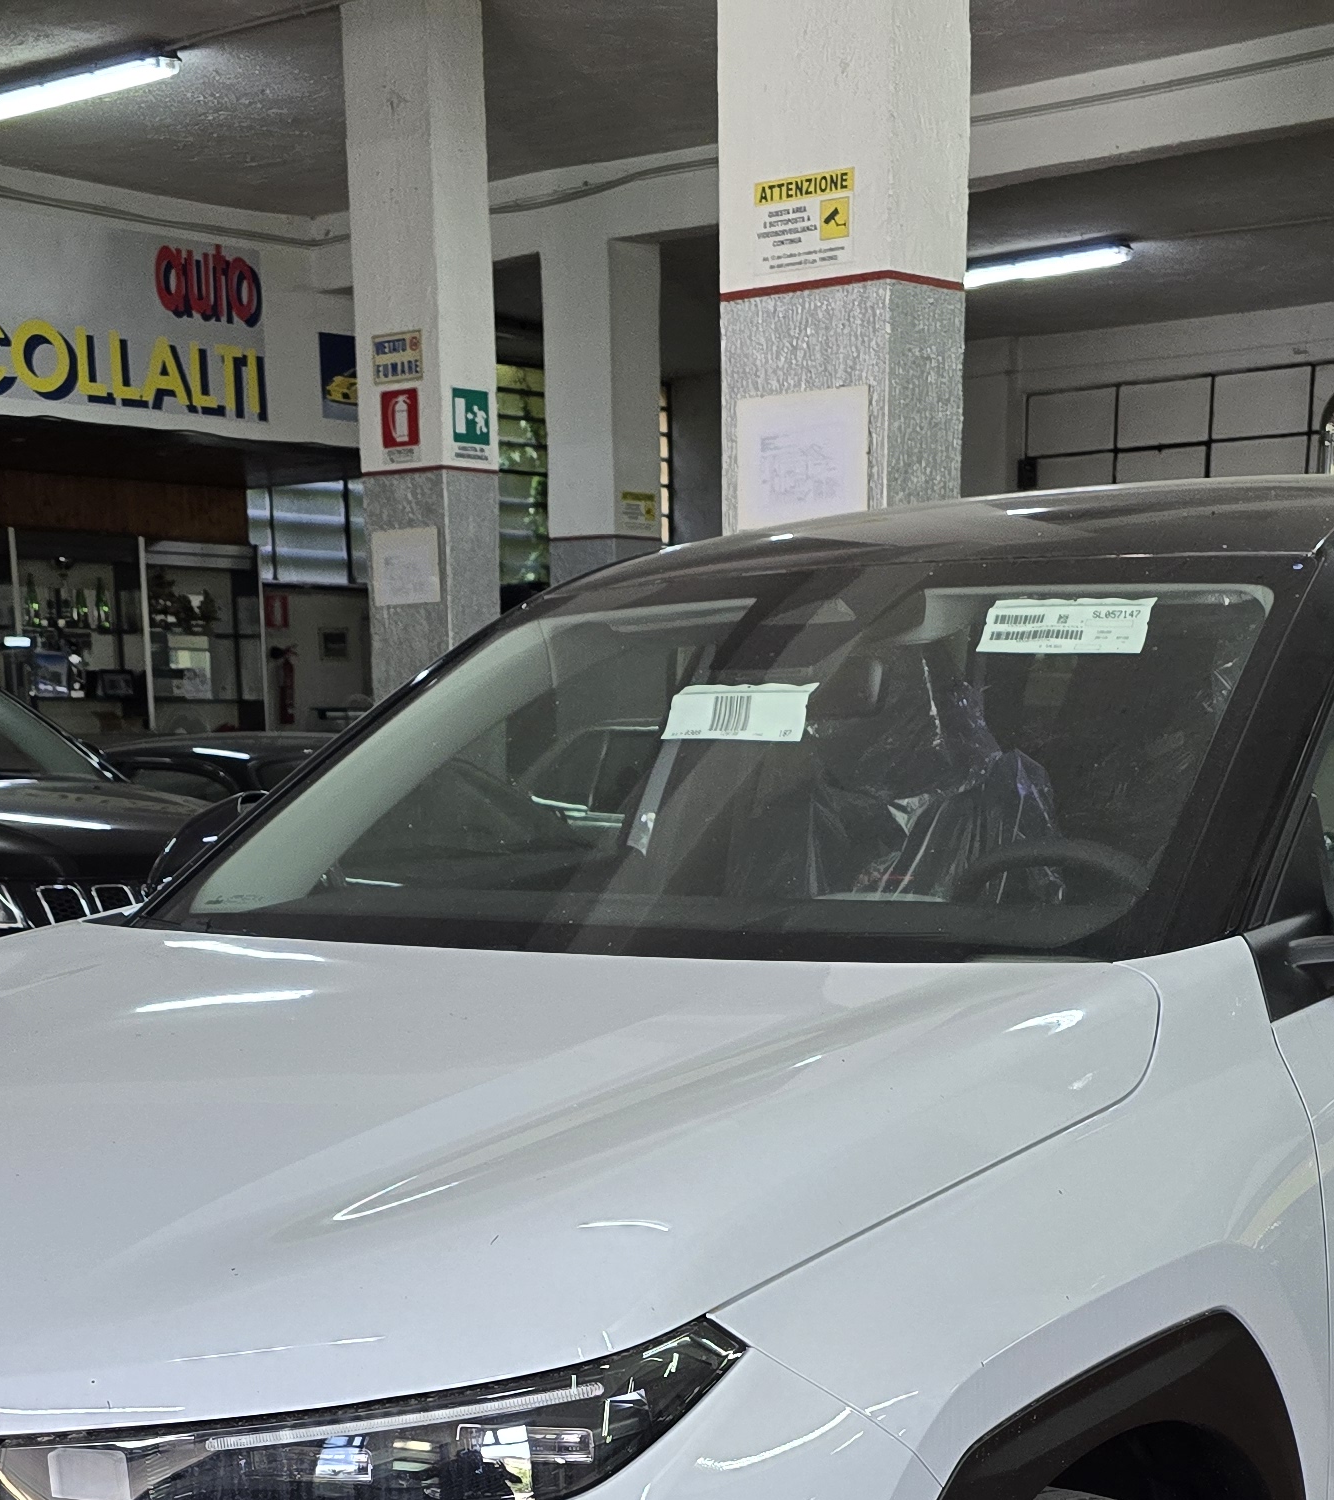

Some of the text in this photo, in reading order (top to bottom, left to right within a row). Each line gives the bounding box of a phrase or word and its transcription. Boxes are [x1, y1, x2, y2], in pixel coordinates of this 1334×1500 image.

[758, 172, 848, 203] ATTENZIONE
[155, 244, 260, 324] auto
[376, 360, 419, 378] FUMARE
[1092, 609, 1141, 619] SL057147
